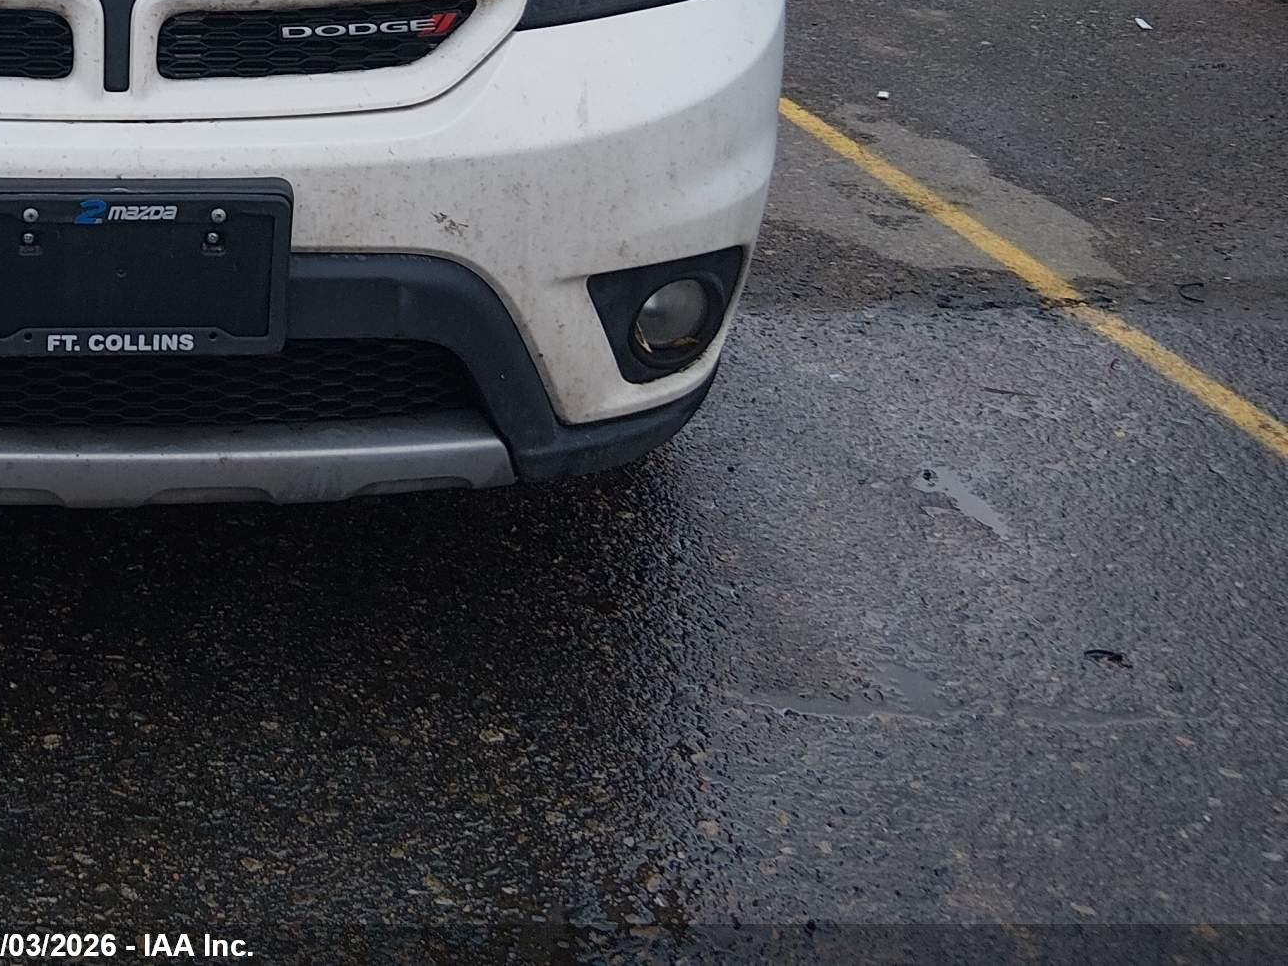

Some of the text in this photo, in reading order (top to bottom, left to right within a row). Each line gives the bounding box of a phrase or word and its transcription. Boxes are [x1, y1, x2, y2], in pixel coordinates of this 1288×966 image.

[282, 19, 436, 39] DODGE
[108, 205, 178, 221] mazda
[47, 334, 195, 352] FT. COLLINS
